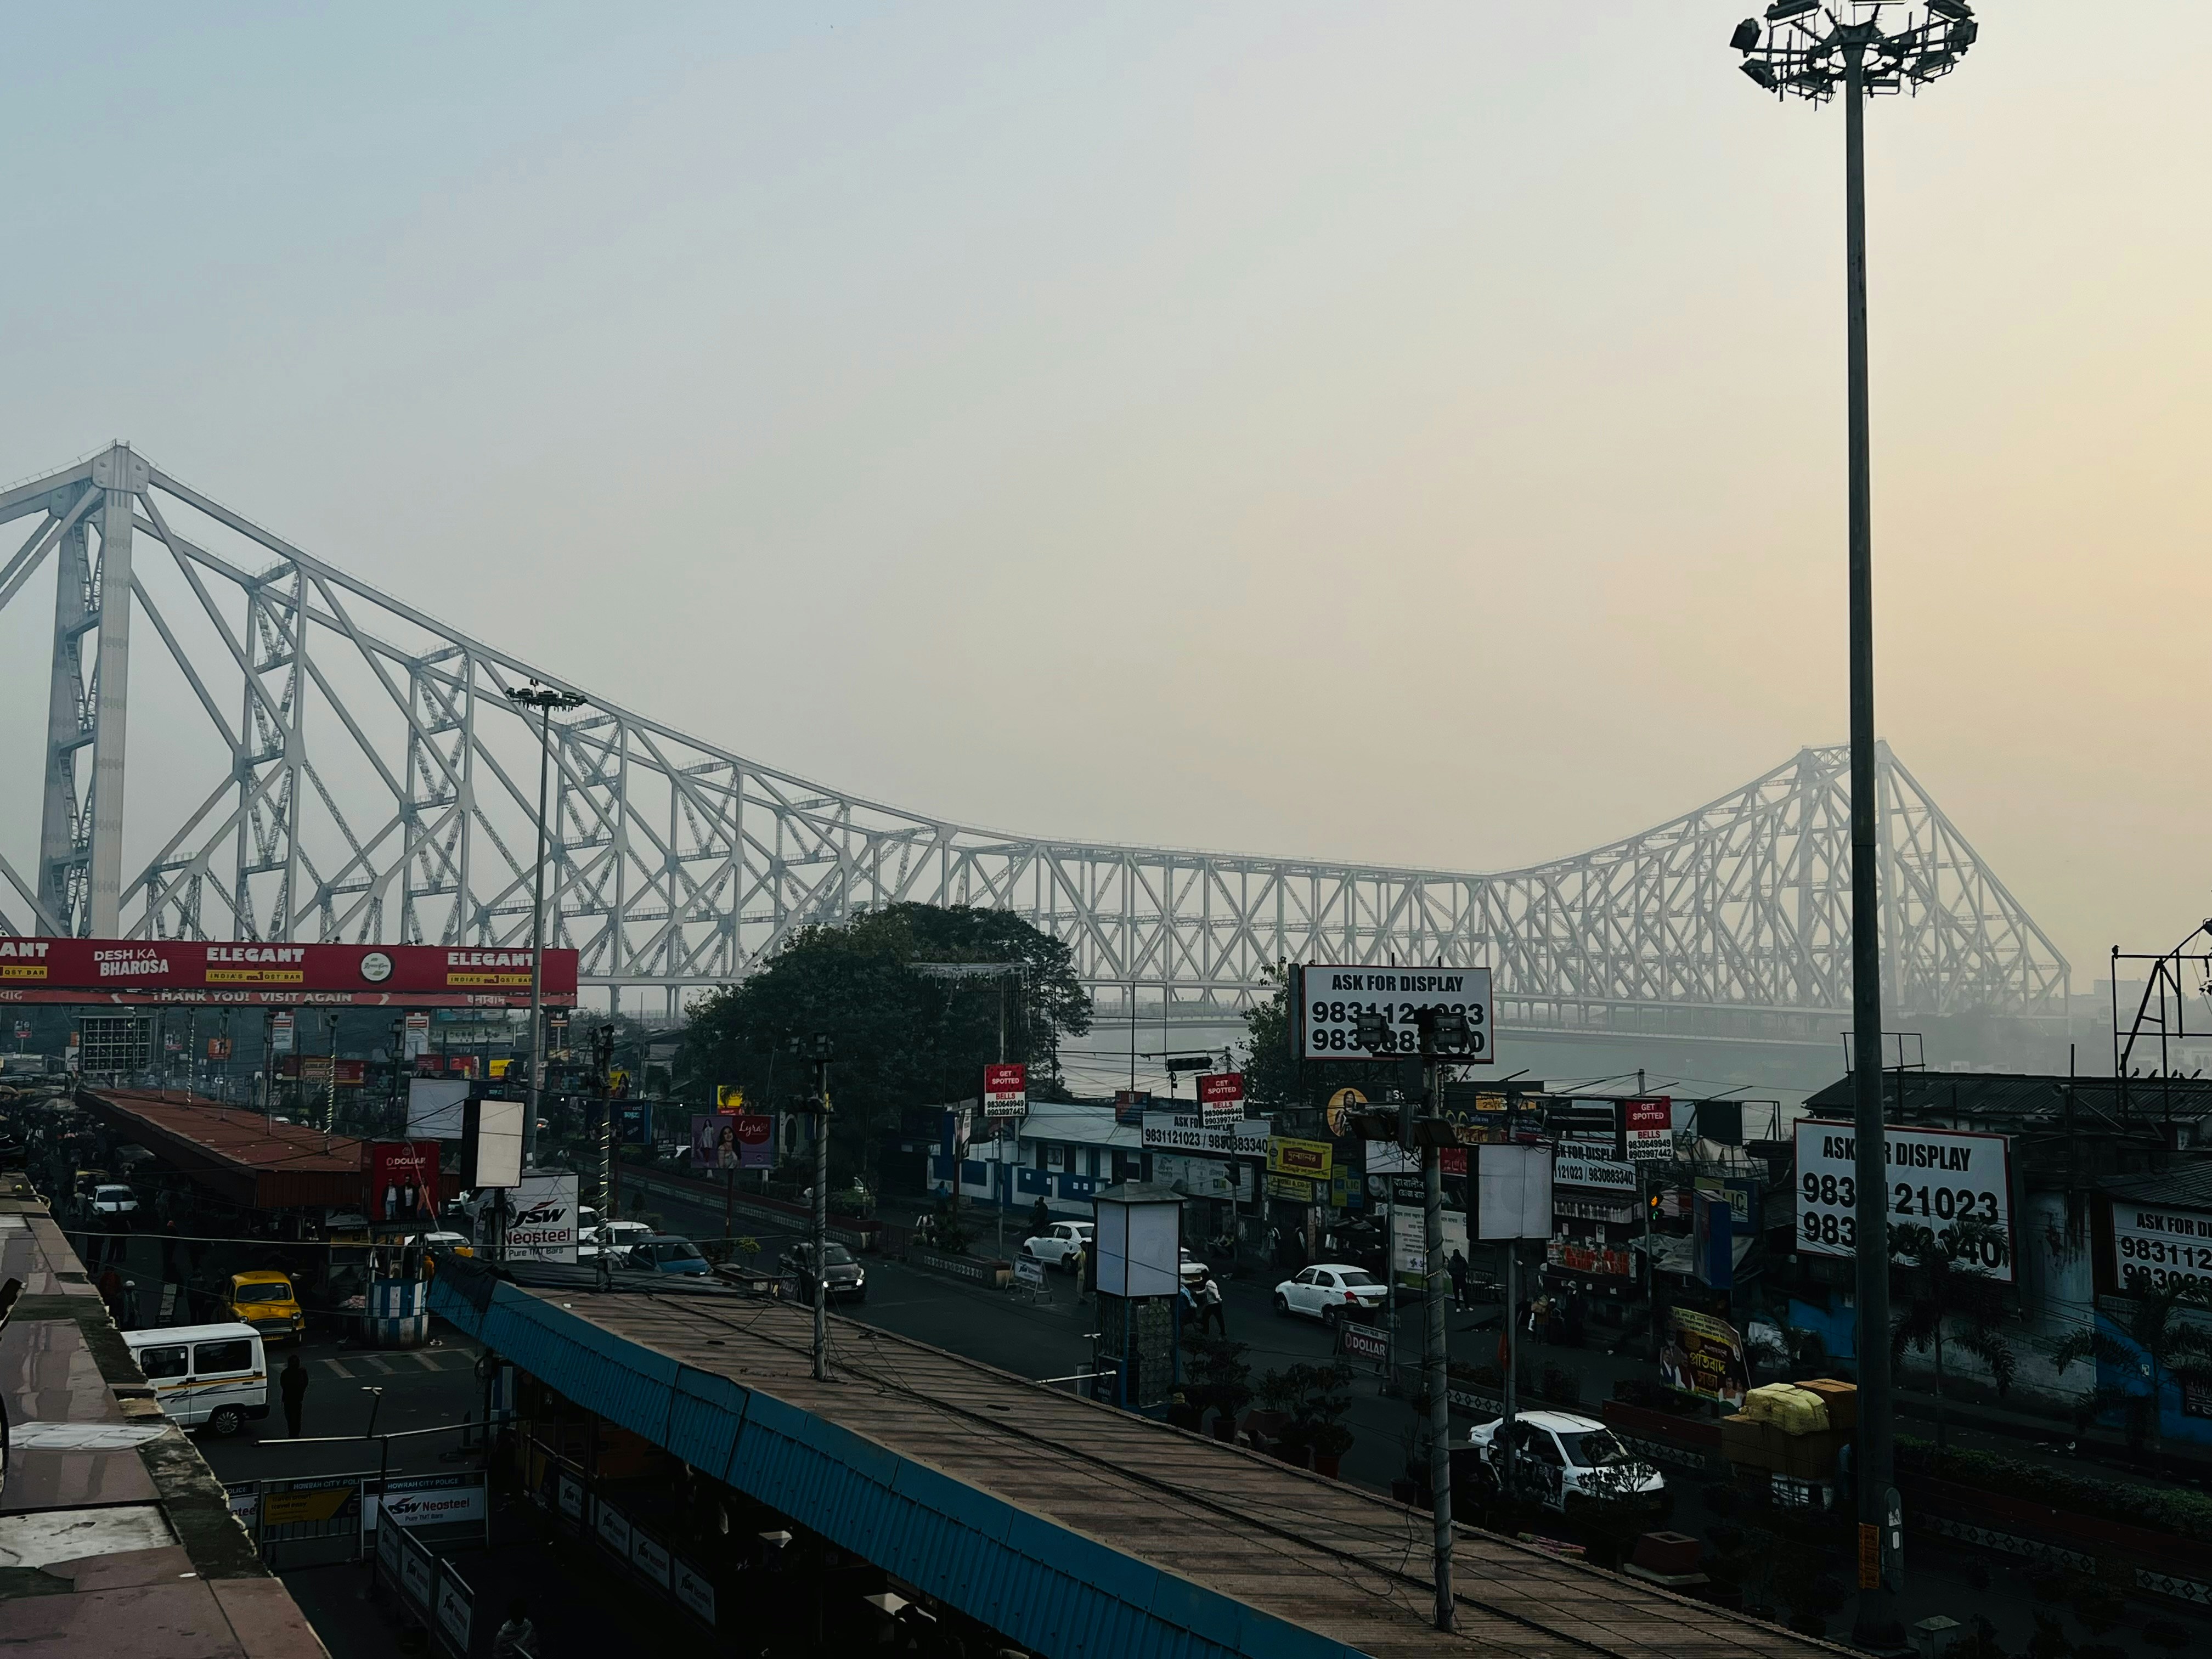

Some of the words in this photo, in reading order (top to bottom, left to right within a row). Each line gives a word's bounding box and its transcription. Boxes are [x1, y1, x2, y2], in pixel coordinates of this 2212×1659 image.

[94, 950, 133, 961] DESH
[137, 948, 157, 958] KA
[206, 947, 305, 962] ELEGANT
[448, 952, 533, 966] ELEGANT
[100, 959, 170, 977] BHAROSA
[1332, 974, 1363, 990] ASK
[1367, 975, 1396, 991] FOR
[1400, 976, 1464, 992] DISPLAY
[153, 992, 207, 1001] THANK
[213, 992, 250, 1002] YOU!
[259, 992, 300, 1002] VISIT
[303, 993, 352, 1002] AGAIN
[1207, 1086, 1237, 1094] SPOTTED
[1174, 1116, 1188, 1128] ASK
[1633, 1112, 1664, 1120] SPOTTED
[739, 1120, 764, 1137] Lyra
[1638, 1131, 1661, 1139] BELLS
[1146, 1128, 1200, 1146] 9831121023
[394, 1157, 426, 1165] DOLLAR
[1568, 1145, 1585, 1160] FOR
[1586, 1147, 1617, 1162] DISPLA
[1823, 1136, 1855, 1160] ASK
[1896, 1142, 1972, 1171] DISPLAY
[1589, 1167, 1633, 1185] 9830883340
[1346, 1181, 1359, 1189] LIC
[1723, 1193, 1744, 1211] IC
[1803, 1172, 1999, 1224] 98321023
[507, 1206, 567, 1229] JSW
[2137, 1212, 2165, 1231] ASK
[2168, 1216, 2194, 1235] FOR
[1352, 1336, 1386, 1357] DOLLAR
[294, 1482, 321, 1490] HOWRAH
[387, 1482, 417, 1490] HOWRAH
[435, 1477, 459, 1486] POLICE
[422, 1497, 470, 1511] Neosteel
